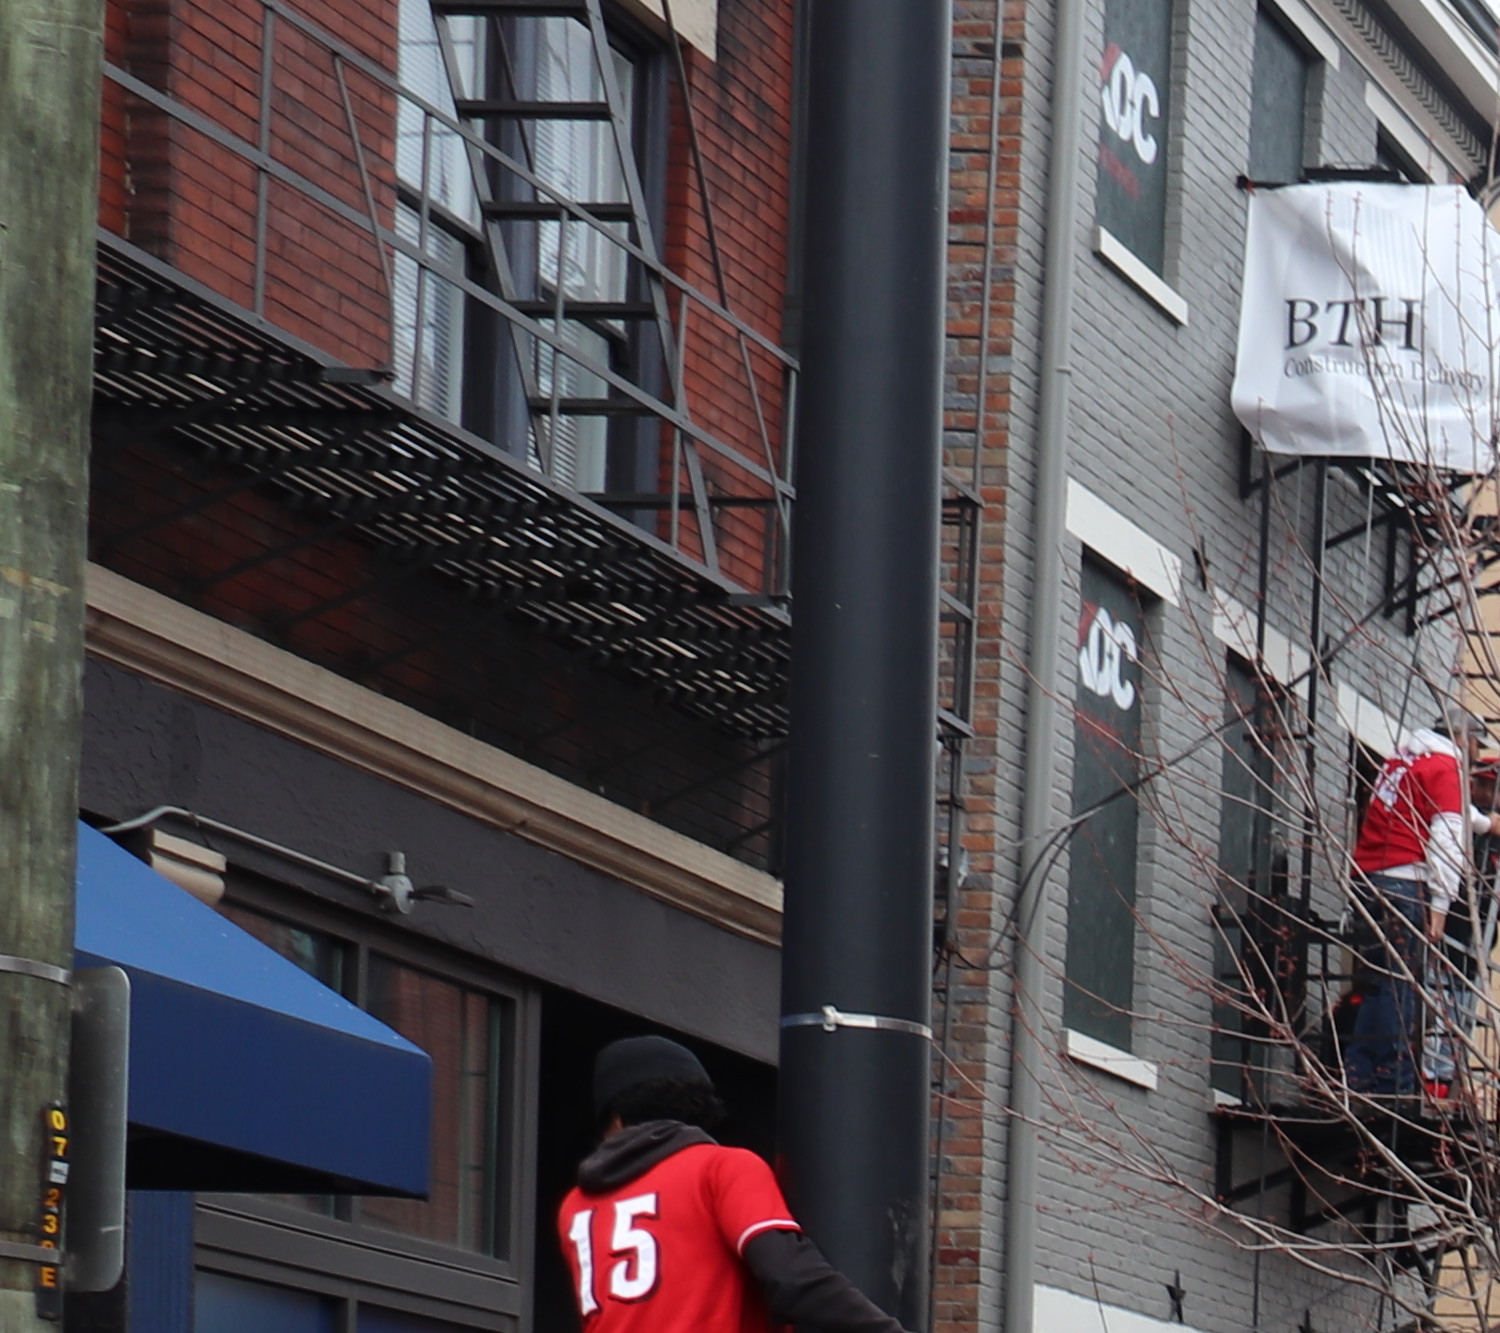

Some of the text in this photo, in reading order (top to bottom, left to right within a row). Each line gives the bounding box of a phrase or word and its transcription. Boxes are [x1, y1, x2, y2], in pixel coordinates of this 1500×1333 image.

[1283, 297, 1422, 350] BTH
[1283, 354, 1487, 395] Construction Delivery
[568, 1193, 659, 1317] 15
